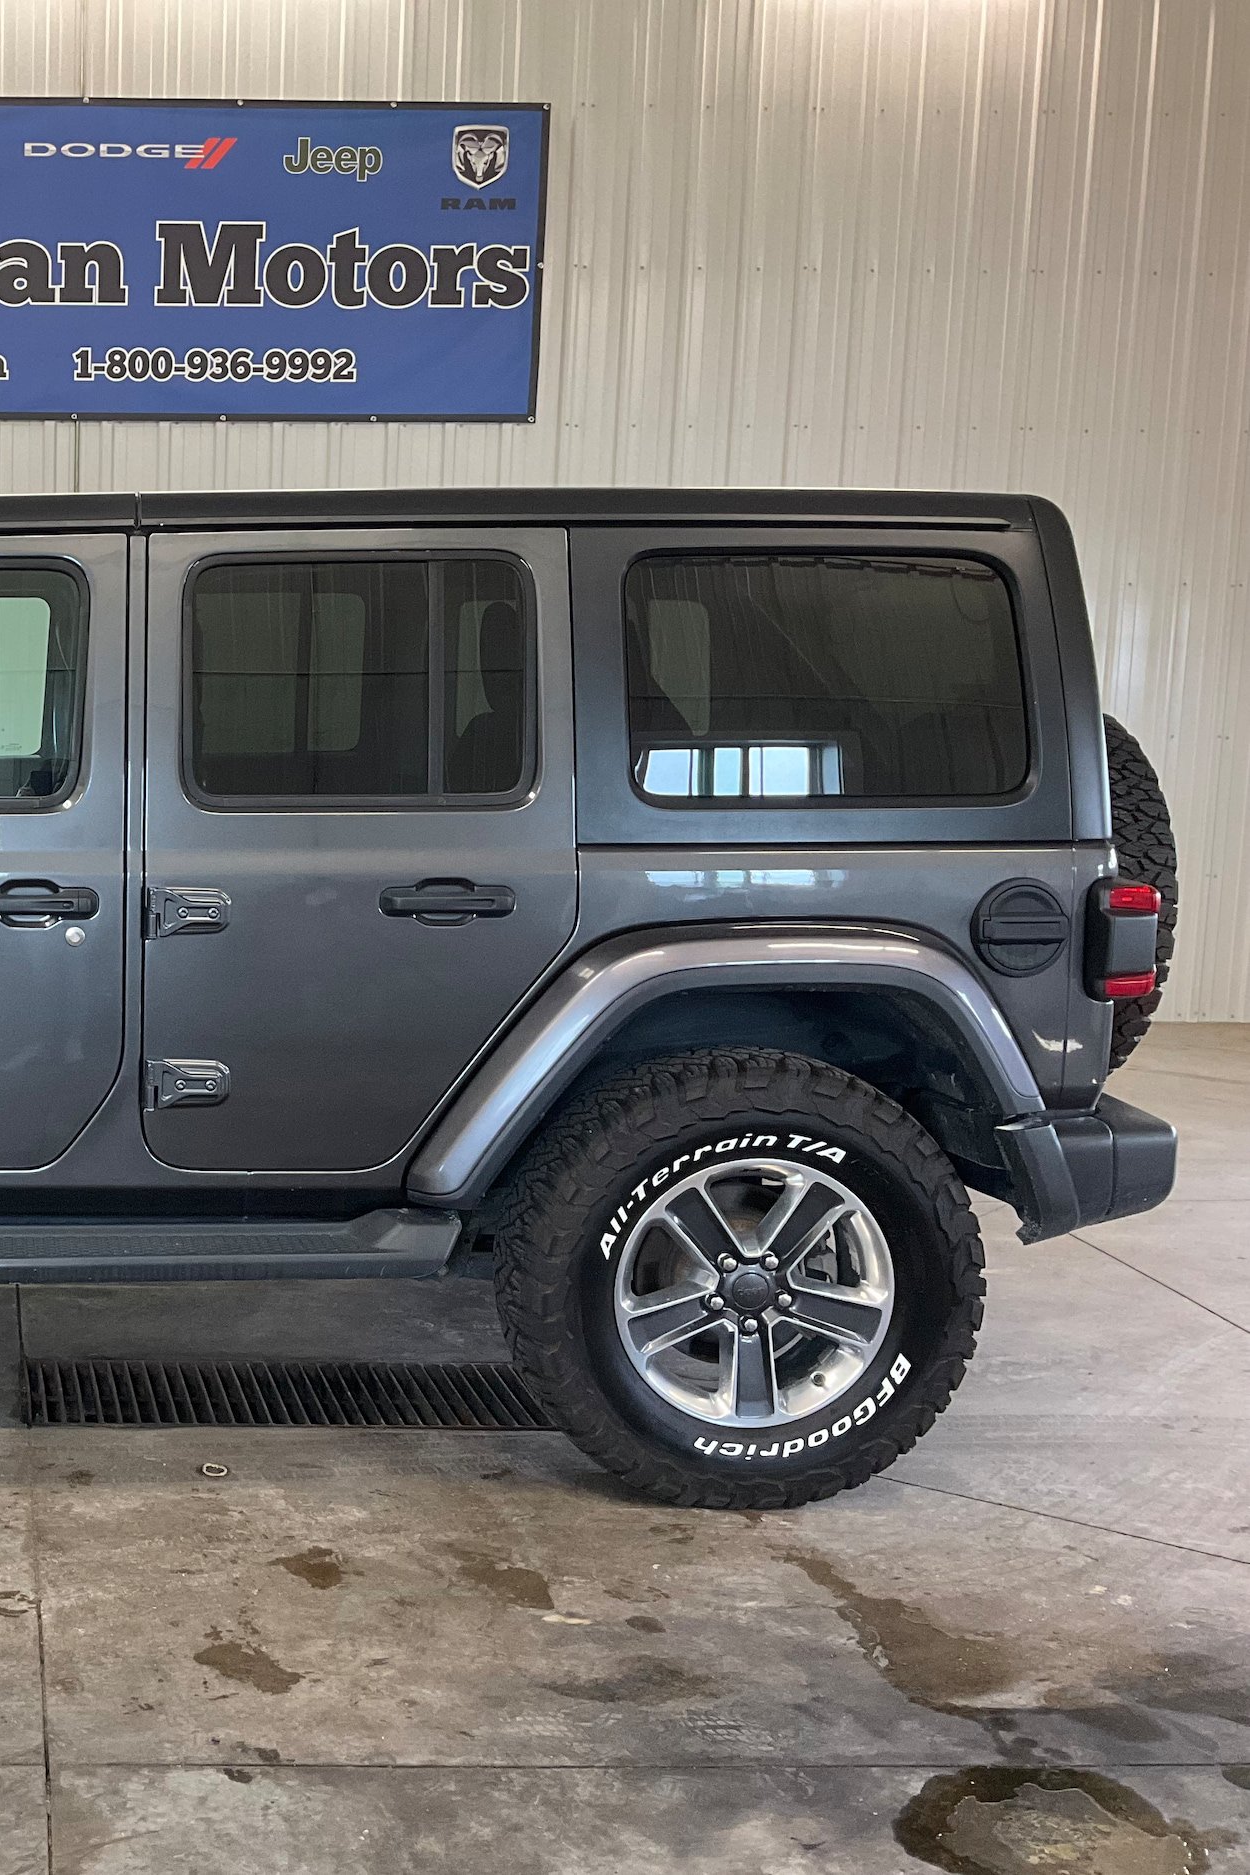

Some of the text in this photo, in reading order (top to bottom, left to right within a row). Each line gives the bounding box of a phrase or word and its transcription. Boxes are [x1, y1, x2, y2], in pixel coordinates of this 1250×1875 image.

[23, 142, 205, 159] DODGE
[283, 137, 383, 182] Jeep
[440, 198, 517, 210] RAM
[153, 220, 530, 309] Motors
[72, 346, 357, 383] 1-800-936-9992
[598, 1132, 847, 1261] All-Terrain T/A
[693, 1352, 912, 1461] BFGoodrich
